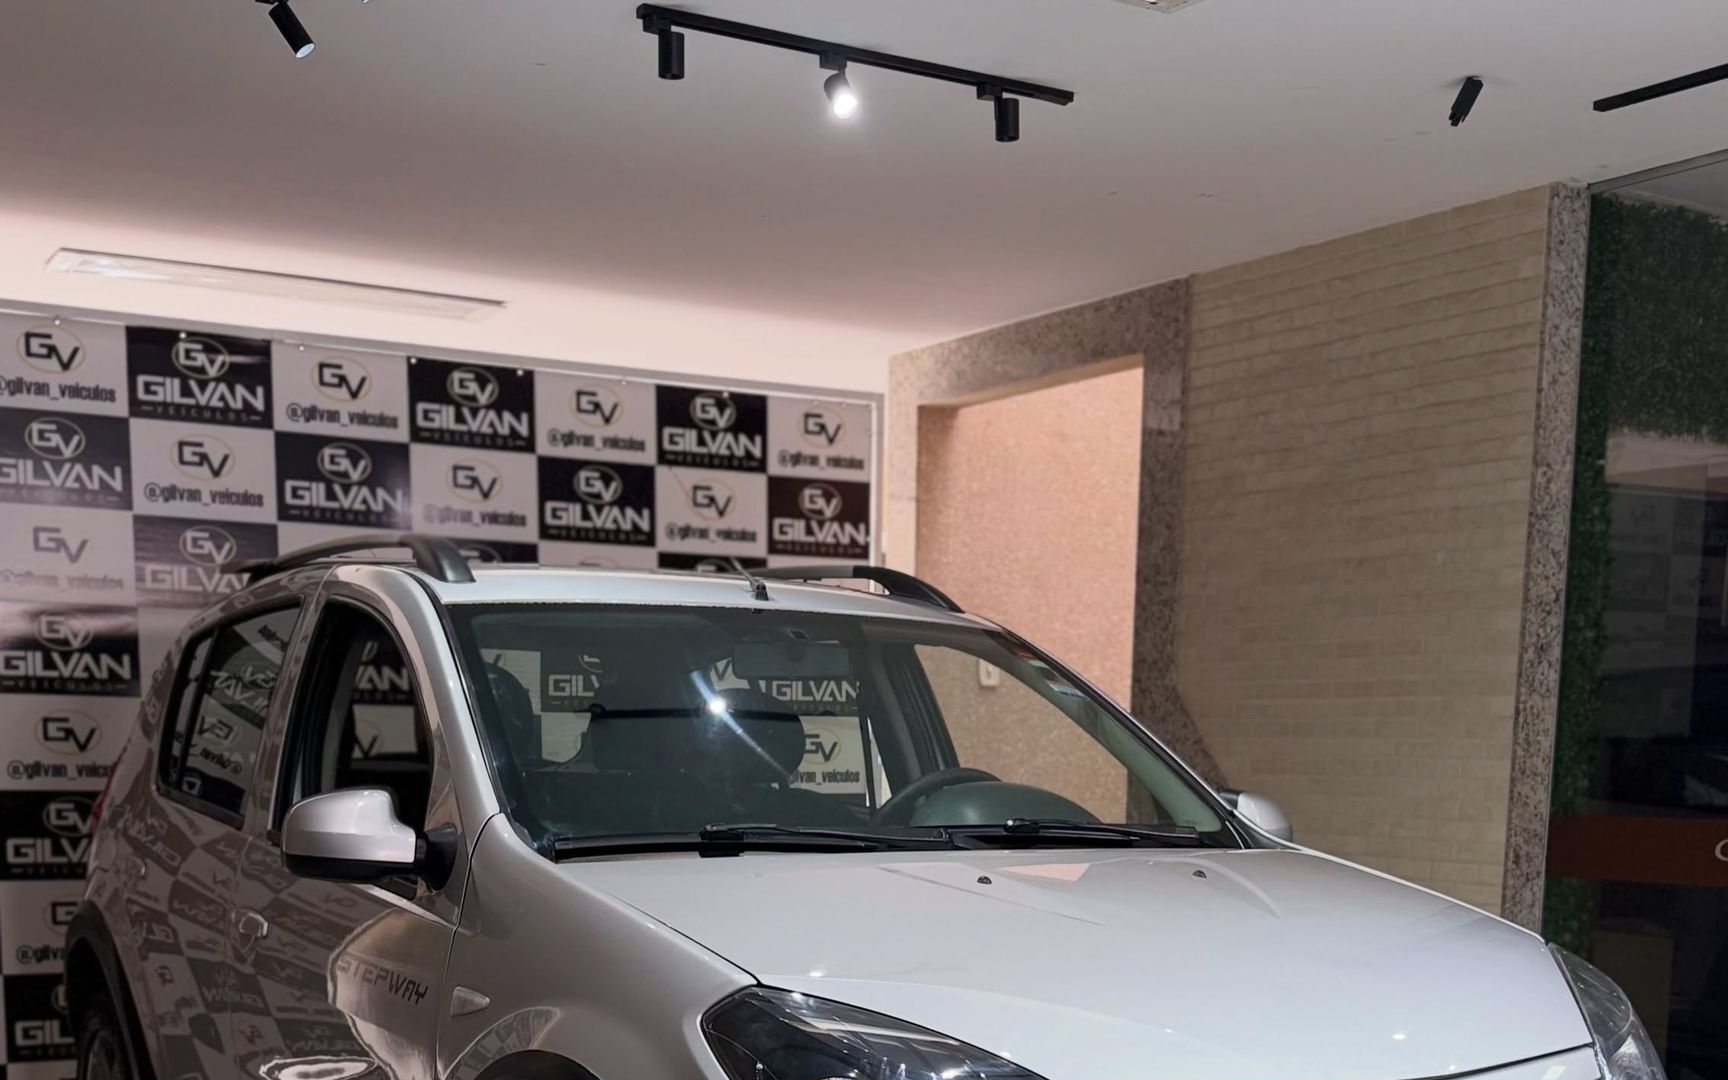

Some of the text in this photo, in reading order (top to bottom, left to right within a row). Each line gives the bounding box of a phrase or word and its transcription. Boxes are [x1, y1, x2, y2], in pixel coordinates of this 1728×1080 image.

[24, 331, 80, 371] GV
[178, 341, 225, 376] GV
[136, 374, 265, 412] GILVAN
[318, 362, 367, 400] GV
[452, 370, 494, 404] GV
[416, 402, 529, 438] GILVAN
[575, 389, 618, 425] GV
[695, 397, 732, 428] GV
[31, 422, 80, 458] GV
[662, 426, 763, 459] GILVAN
[804, 412, 842, 445] GV
[0, 457, 123, 492] GILVAN
[178, 440, 230, 479] GV
[323, 447, 368, 481] GV
[284, 479, 404, 513] GILVAN
[452, 464, 498, 500] GV
[579, 470, 618, 502] GV
[544, 500, 651, 533] GILVAN
[692, 485, 732, 518] GV
[803, 488, 837, 518] GV
[32, 525, 89, 565] GV
[185, 530, 232, 564] GV
[772, 517, 867, 547] GILVAN
[40, 615, 88, 649] GV
[0, 650, 132, 680] GILVAN
[772, 680, 861, 703] GILVAN
[42, 717, 97, 753] GV
[6, 838, 92, 864] GILV
[337, 957, 430, 1005] STEPWAY
